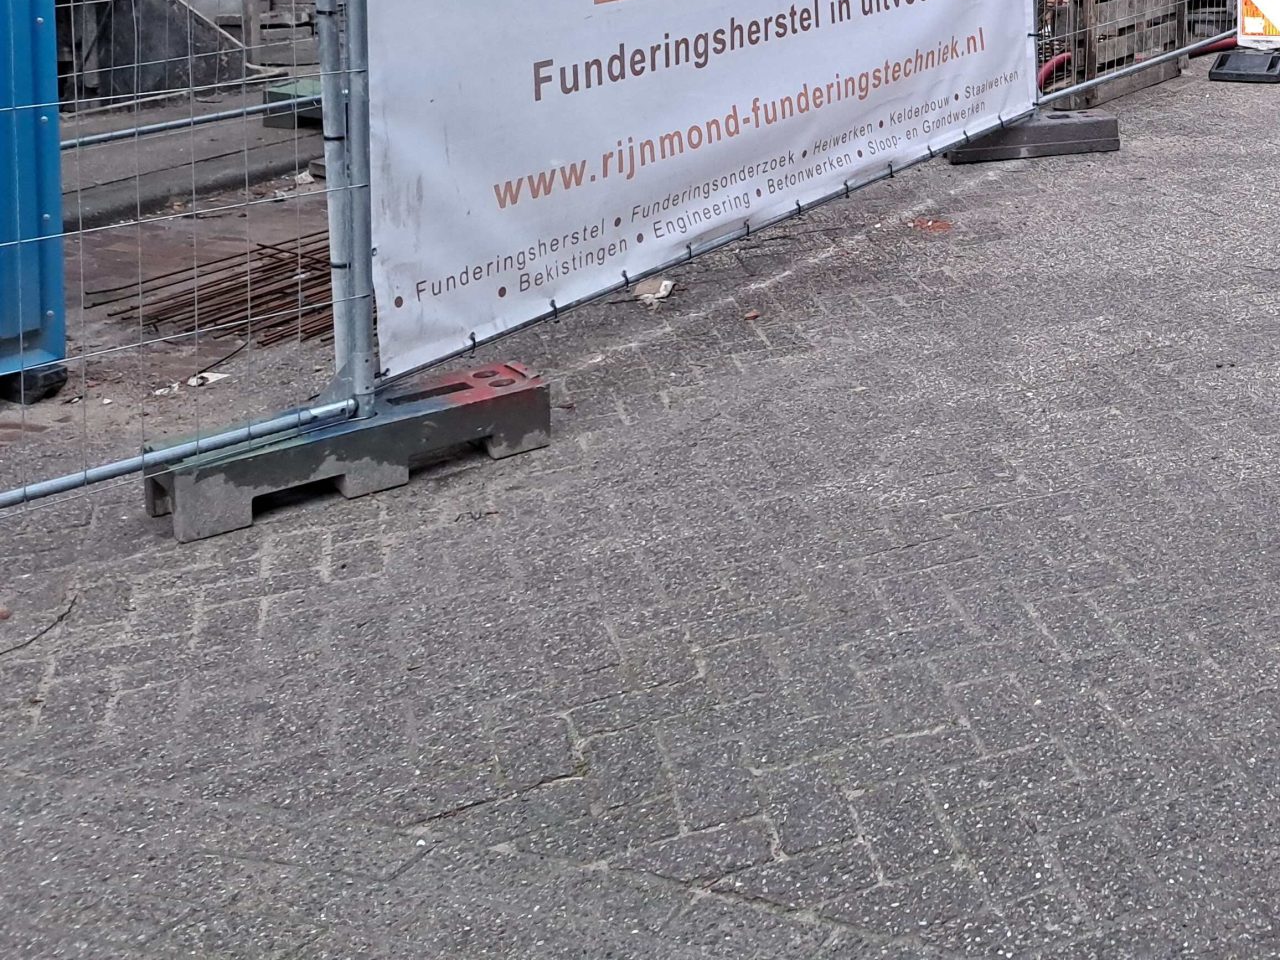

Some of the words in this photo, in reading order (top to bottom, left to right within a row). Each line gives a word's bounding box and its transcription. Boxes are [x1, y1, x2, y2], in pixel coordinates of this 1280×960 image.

[493, 27, 986, 209] www.rijnmond-funderingstechniek.nl
[533, 0, 820, 102] Funderingsherstel
[415, 218, 605, 303] Funderingsherstel
[631, 150, 795, 224] Funderingsonderzoek
[812, 120, 873, 156] Heiwerken
[889, 95, 950, 127] Kelderbouw
[964, 69, 1019, 100] Staalwerken
[519, 238, 628, 293] Bekistingen
[653, 191, 751, 239] Engineering
[767, 152, 852, 194] Betonwerken
[867, 135, 902, 156] Sloop-
[906, 127, 919, 141] en
[922, 101, 986, 135] Grondwerken
